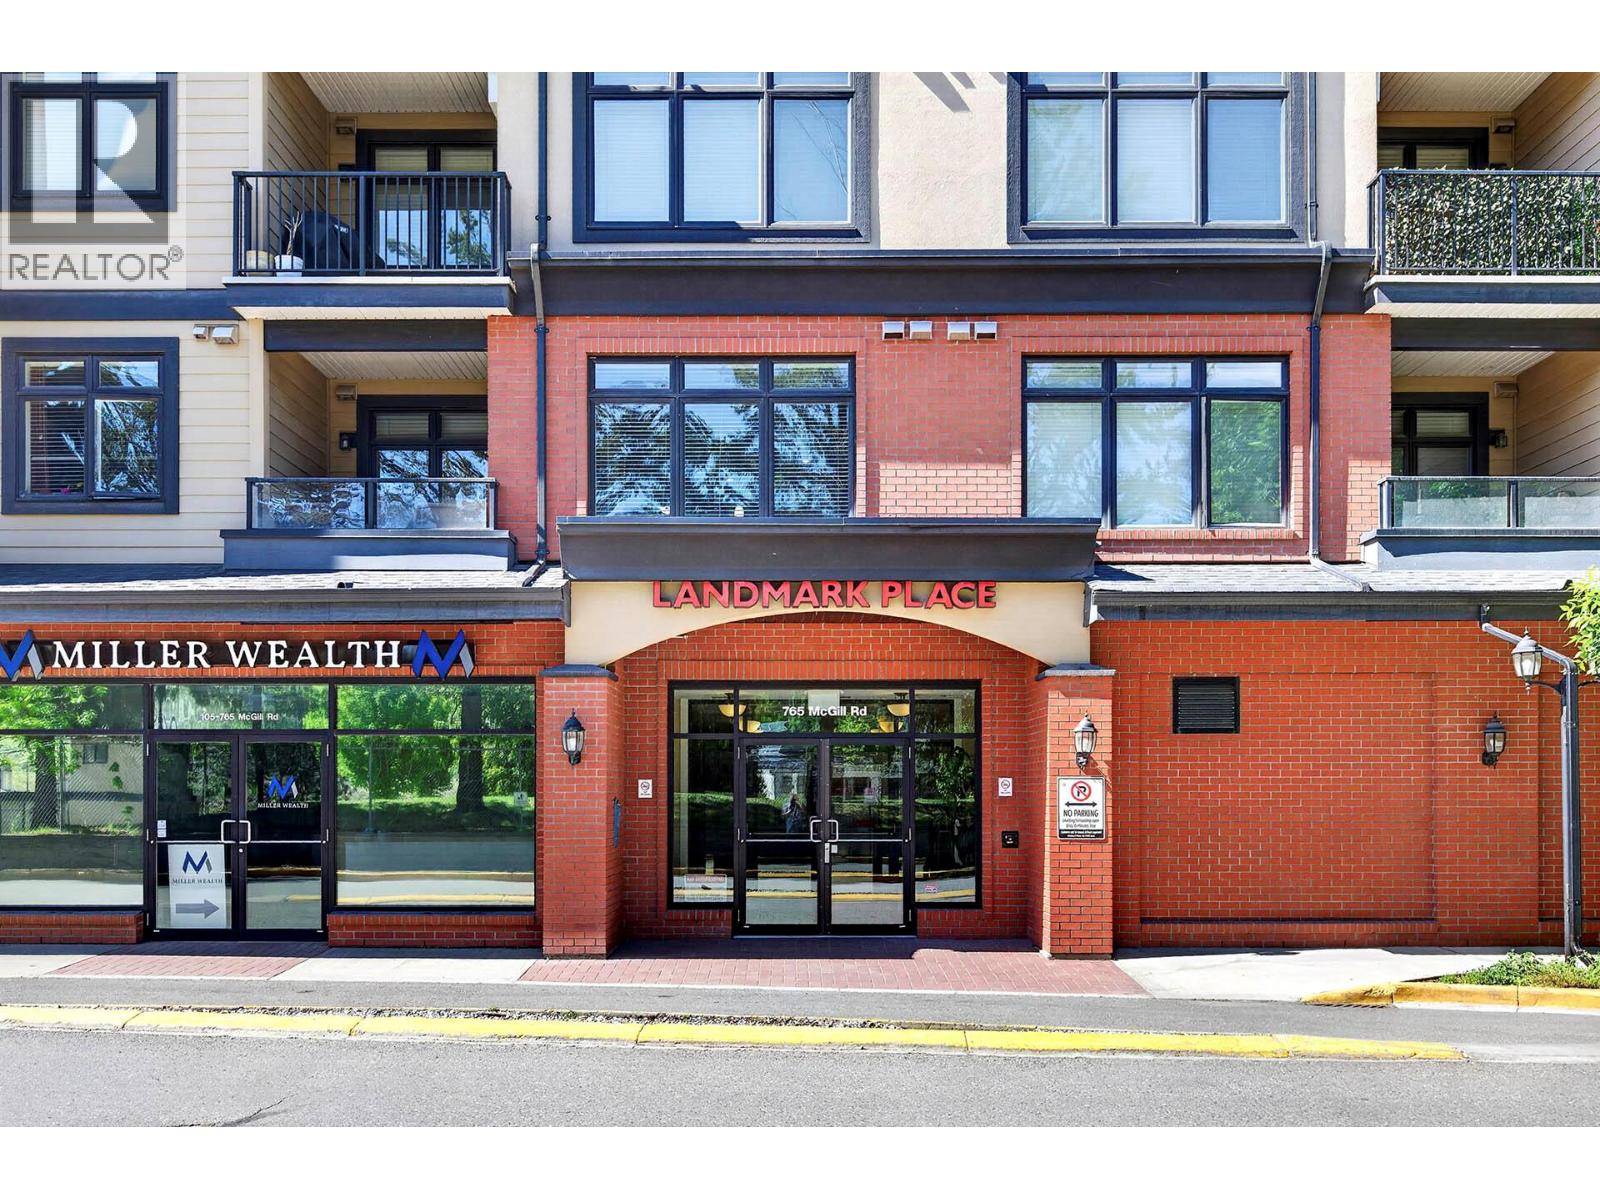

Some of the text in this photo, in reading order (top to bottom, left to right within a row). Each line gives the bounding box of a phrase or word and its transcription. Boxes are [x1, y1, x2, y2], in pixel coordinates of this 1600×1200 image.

[652, 580, 997, 609] LANDMARK PLACE
[52, 640, 211, 669] MILLER
[225, 640, 401, 668] WEALTH
[201, 712, 280, 721] 105-765 McGill Rd
[782, 705, 868, 717] 765 McGill Rd
[1063, 809, 1099, 818] NO PARKING
